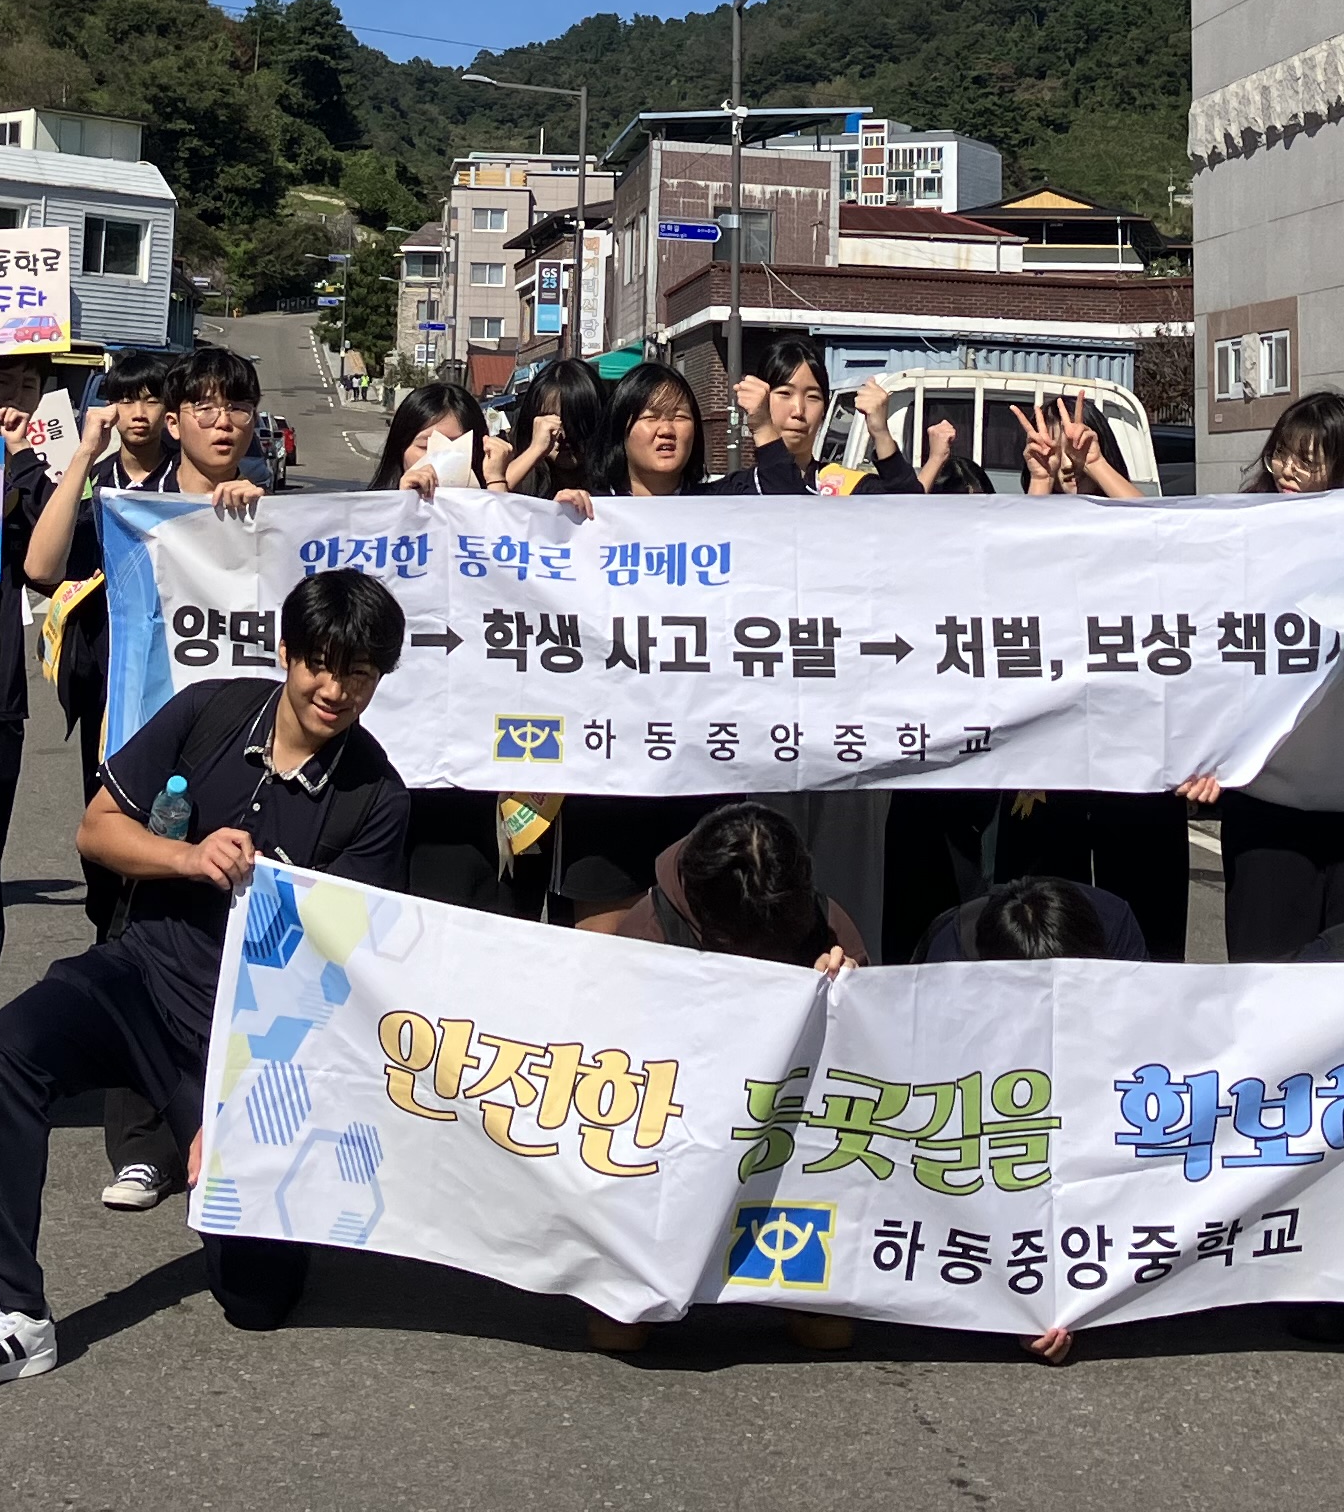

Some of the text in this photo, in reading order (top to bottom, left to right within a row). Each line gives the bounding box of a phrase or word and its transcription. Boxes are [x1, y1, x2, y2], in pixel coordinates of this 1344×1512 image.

[541, 267, 558, 278] GS
[542, 278, 558, 289] 25
[299, 533, 732, 587] 안전한 통학로 캠페인
[172, 604, 276, 667] 양면
[483, 608, 582, 674] 학생
[605, 614, 711, 674] 사고
[732, 617, 842, 679] 유발
[935, 615, 1064, 681] 처벌,
[1086, 613, 1196, 676] 보상
[377, 1008, 684, 1178] 안전한
